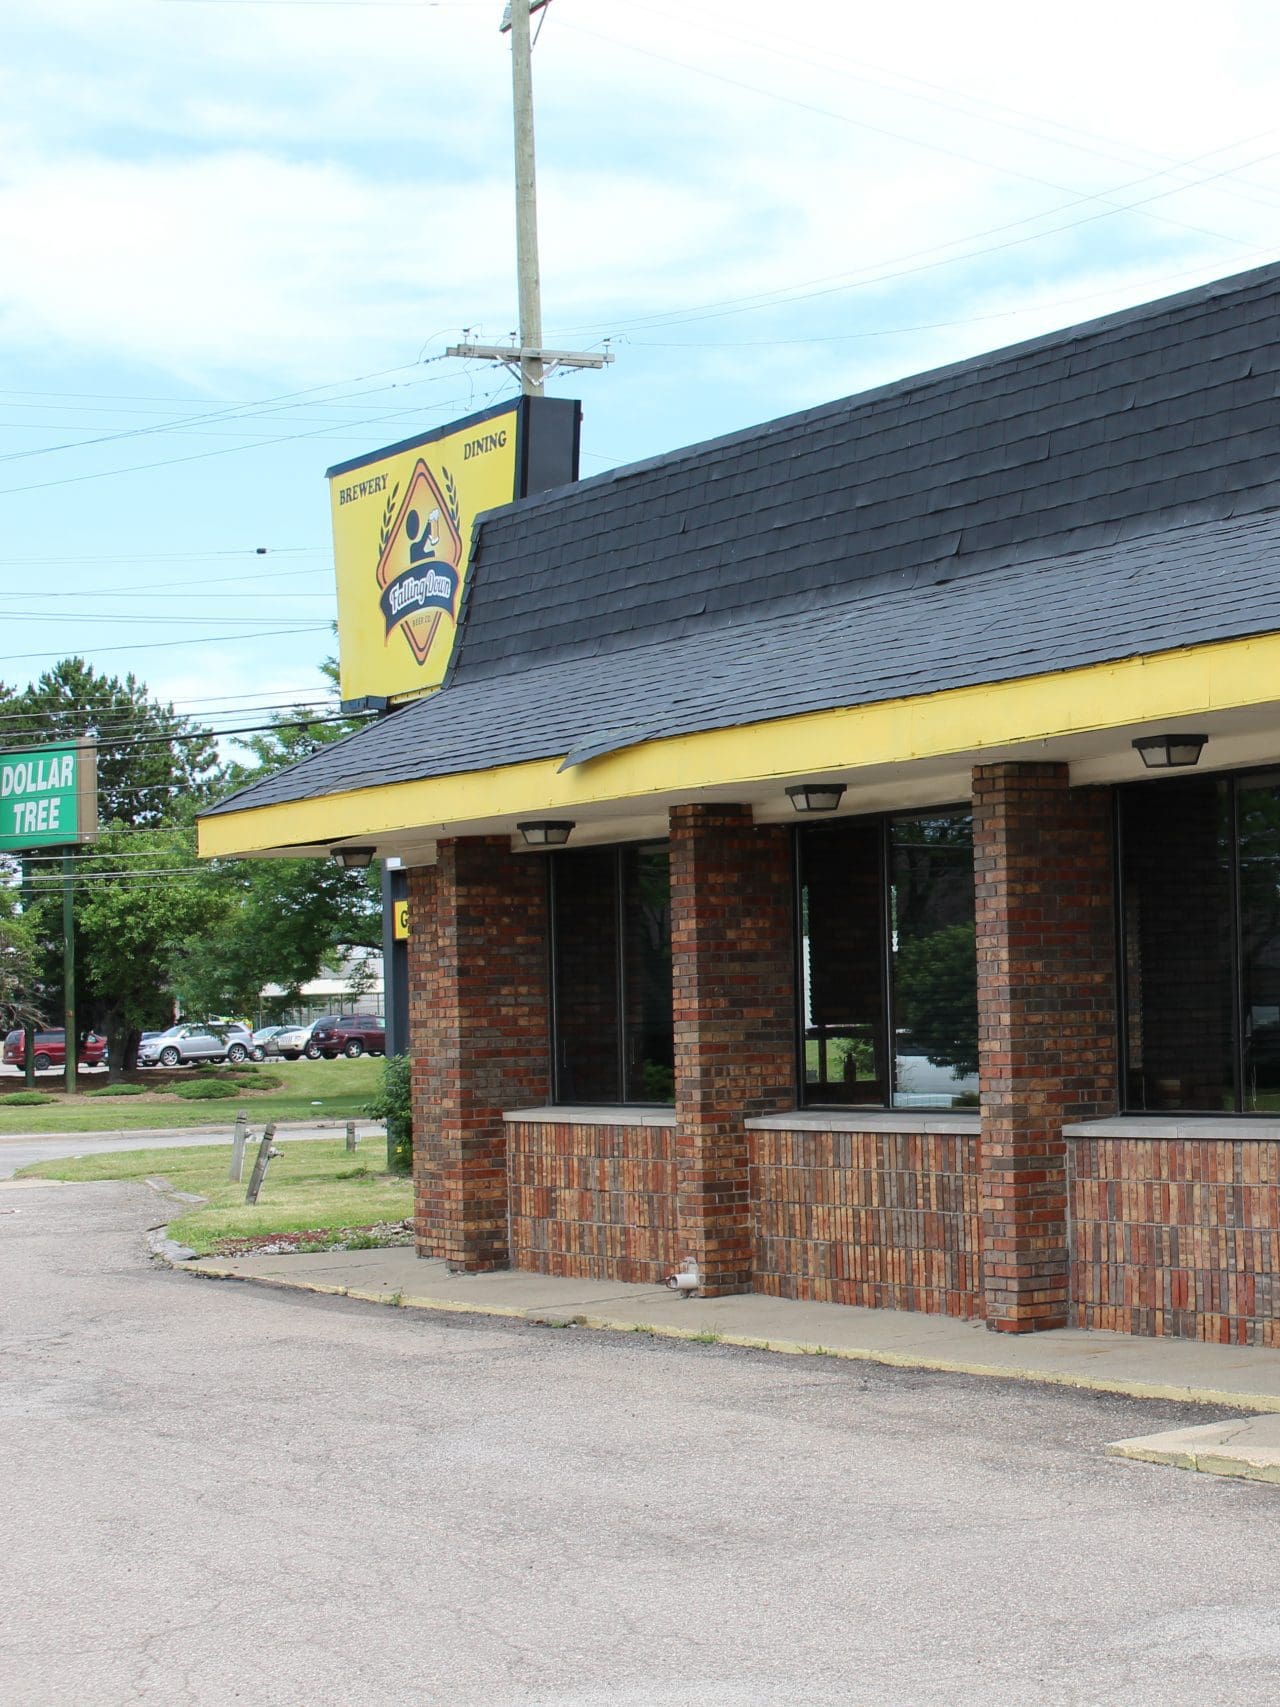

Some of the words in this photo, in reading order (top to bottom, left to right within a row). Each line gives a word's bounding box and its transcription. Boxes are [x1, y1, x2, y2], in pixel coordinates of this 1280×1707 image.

[464, 430, 507, 461] DINING
[339, 473, 389, 506] BREWERY
[389, 577, 427, 615] Falling
[426, 569, 451, 598] Down
[1, 755, 74, 797] DOLLAR
[13, 797, 61, 834] TREE
